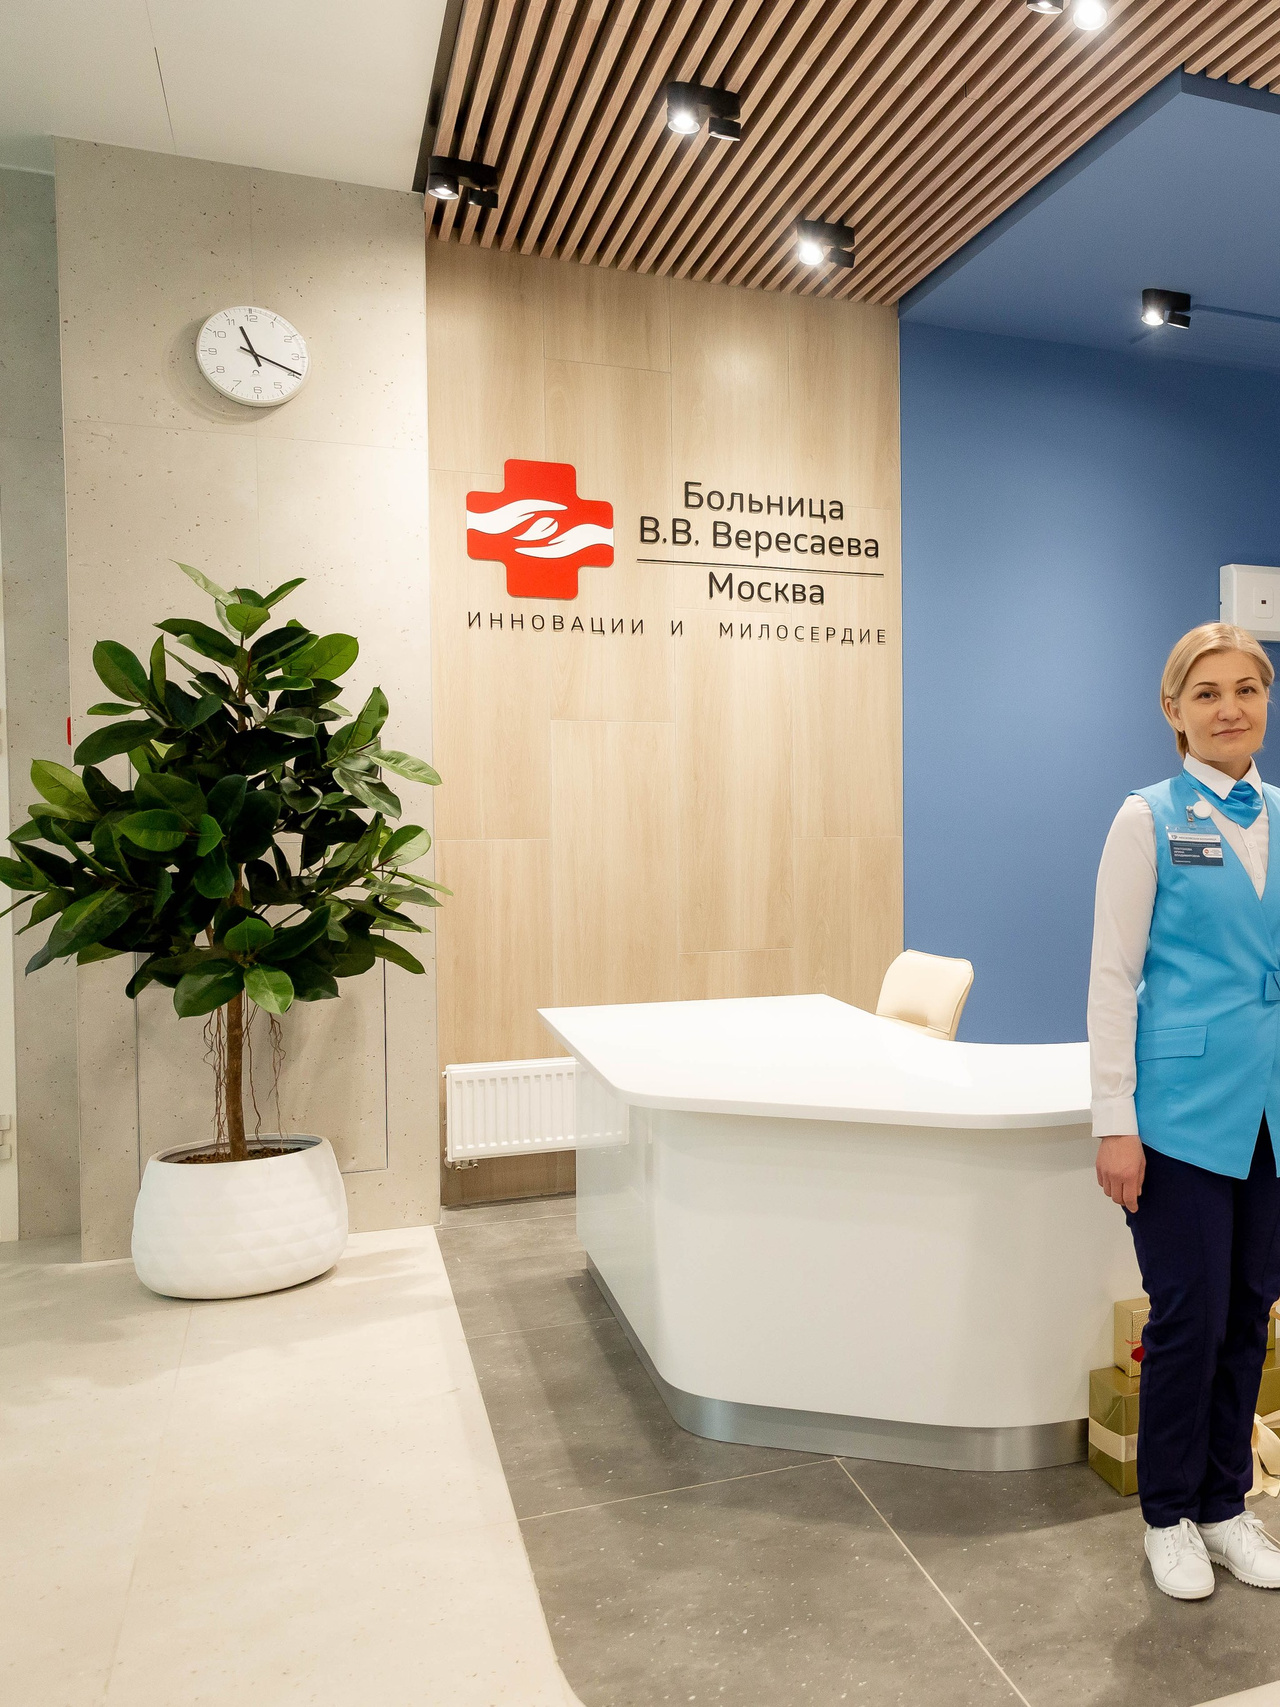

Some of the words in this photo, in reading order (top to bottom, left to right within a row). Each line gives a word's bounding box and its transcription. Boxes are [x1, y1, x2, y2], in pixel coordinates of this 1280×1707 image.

[226, 318, 236, 326] 11
[244, 314, 258, 323] 12
[213, 330, 227, 338] 10
[283, 335, 293, 343] 2
[208, 347, 217, 355] 9
[233, 379, 242, 388] 7
[273, 381, 282, 389] 5
[253, 386, 262, 394] 6
[683, 481, 845, 522] Больница
[639, 515, 700, 547] В.В.
[712, 520, 880, 559] Вересаева
[708, 571, 826, 605] Москва
[468, 611, 645, 637] ИННОВАЦИИ
[670, 620, 685, 637] И
[719, 622, 887, 647] МИЛОСЕРДИЕ
